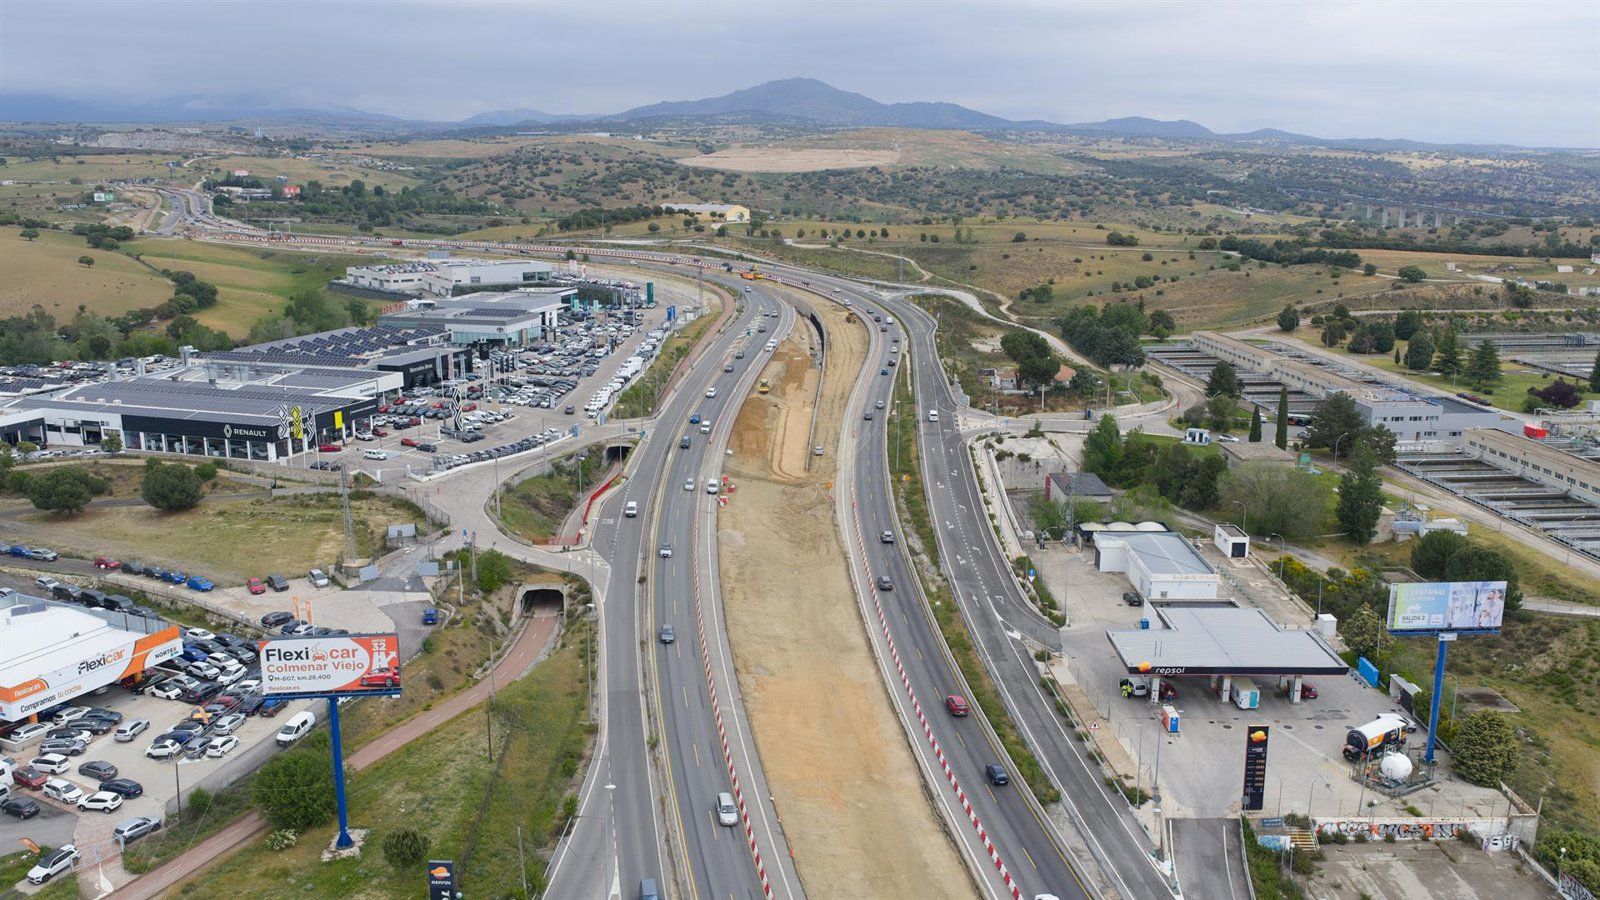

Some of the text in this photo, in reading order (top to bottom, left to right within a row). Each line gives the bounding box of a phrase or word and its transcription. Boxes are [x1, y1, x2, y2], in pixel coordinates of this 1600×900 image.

[234, 428, 267, 437] RENAULT
[372, 642, 386, 651] 32
[265, 647, 358, 662] Flexi car
[78, 650, 125, 674] Flexicar
[266, 660, 365, 673] Colmenar Viejo
[1156, 667, 1185, 675] repsol
[20, 694, 56, 713] Compramos
